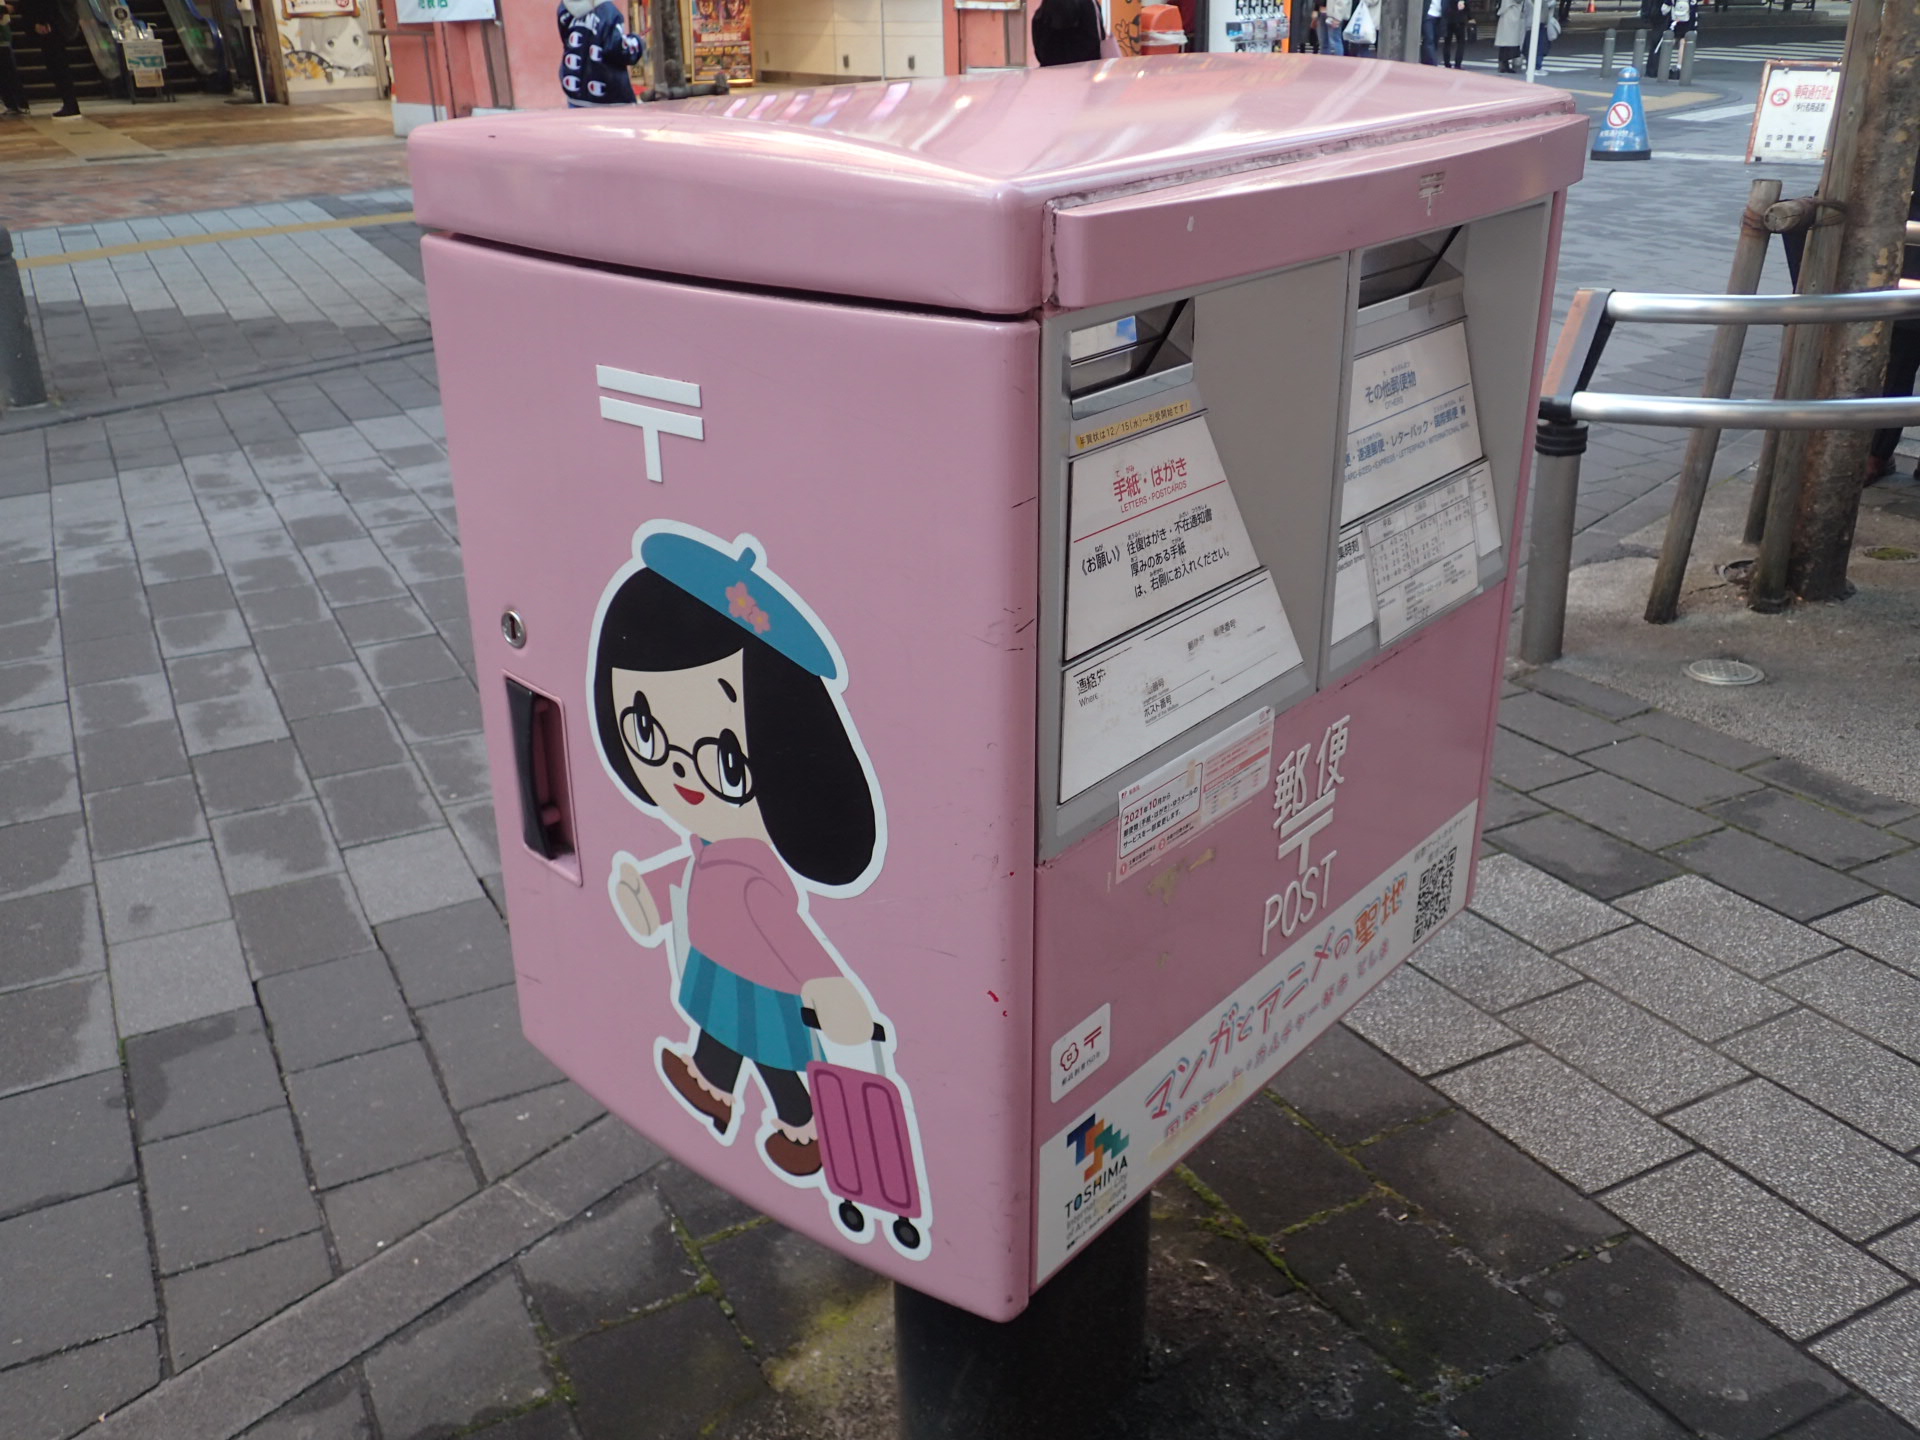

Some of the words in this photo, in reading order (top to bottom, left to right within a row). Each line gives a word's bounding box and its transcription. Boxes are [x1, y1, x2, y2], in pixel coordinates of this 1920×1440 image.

[1365, 370, 1416, 403] その他郵便物
[1113, 457, 1188, 502] 手紙・はがき
[1131, 541, 1187, 577] 厚みのある手紙
[1143, 694, 1172, 718] ポスト番号
[1273, 714, 1350, 829] 郵便
[1261, 850, 1338, 956] POST
[1145, 872, 1408, 1120] マンガとアニメの聖地
[1065, 1155, 1128, 1219] TOSHIMA
